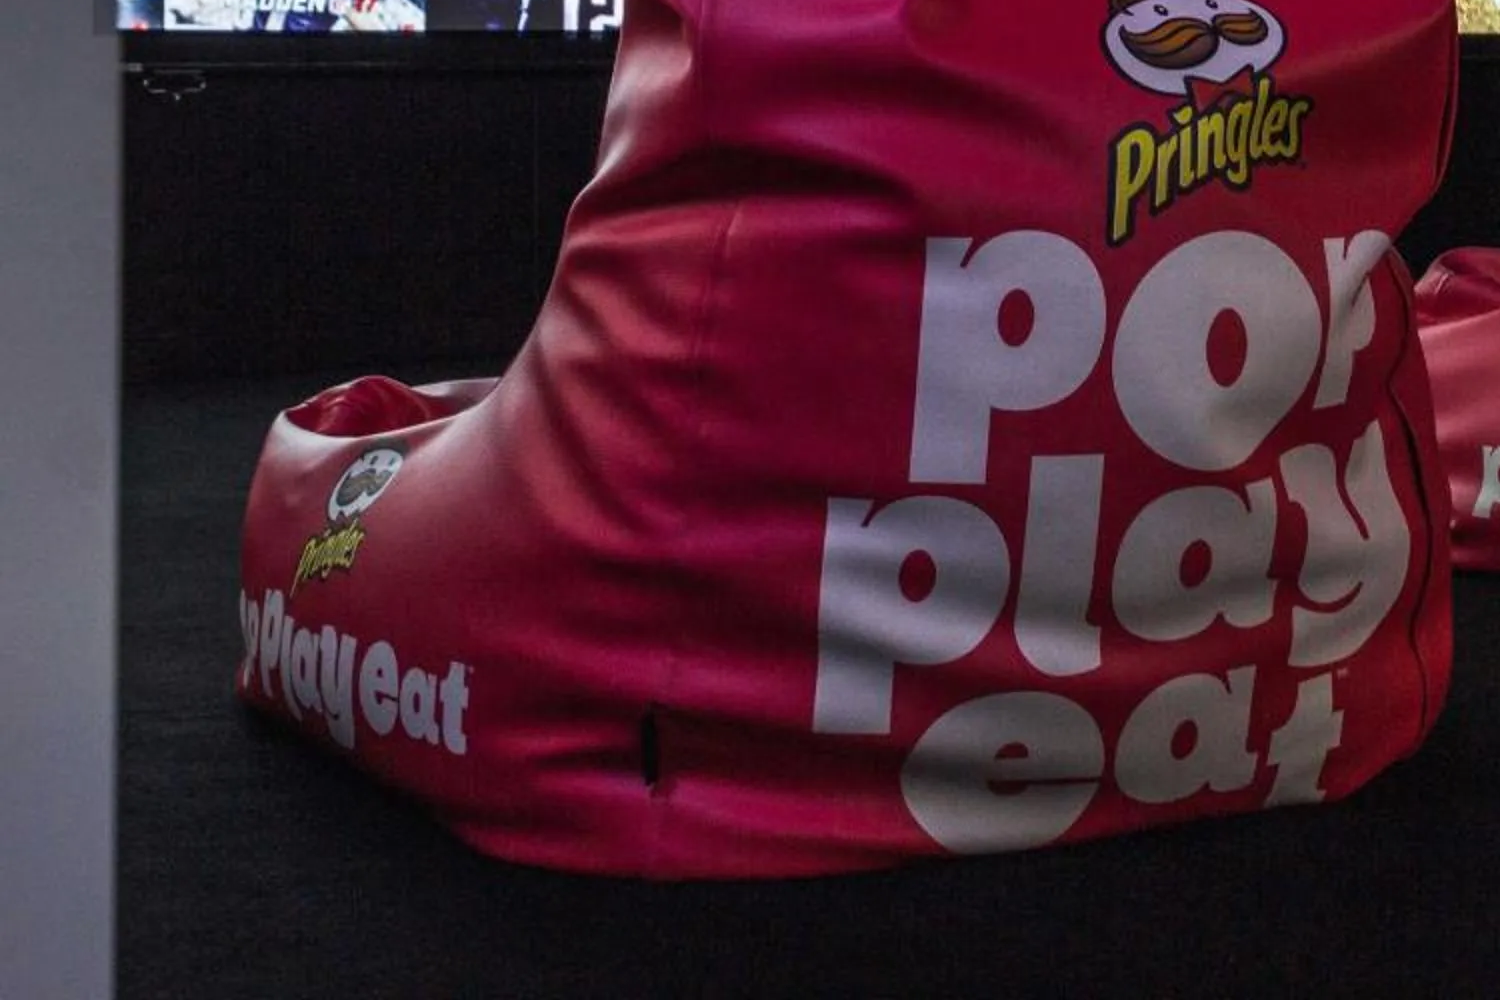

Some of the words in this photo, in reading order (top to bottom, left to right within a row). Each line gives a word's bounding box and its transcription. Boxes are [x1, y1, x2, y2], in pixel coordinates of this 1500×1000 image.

[1109, 77, 1311, 242] Pringles
[812, 419, 1411, 734] play
[358, 640, 470, 756] eat
[901, 664, 1343, 854] eat
